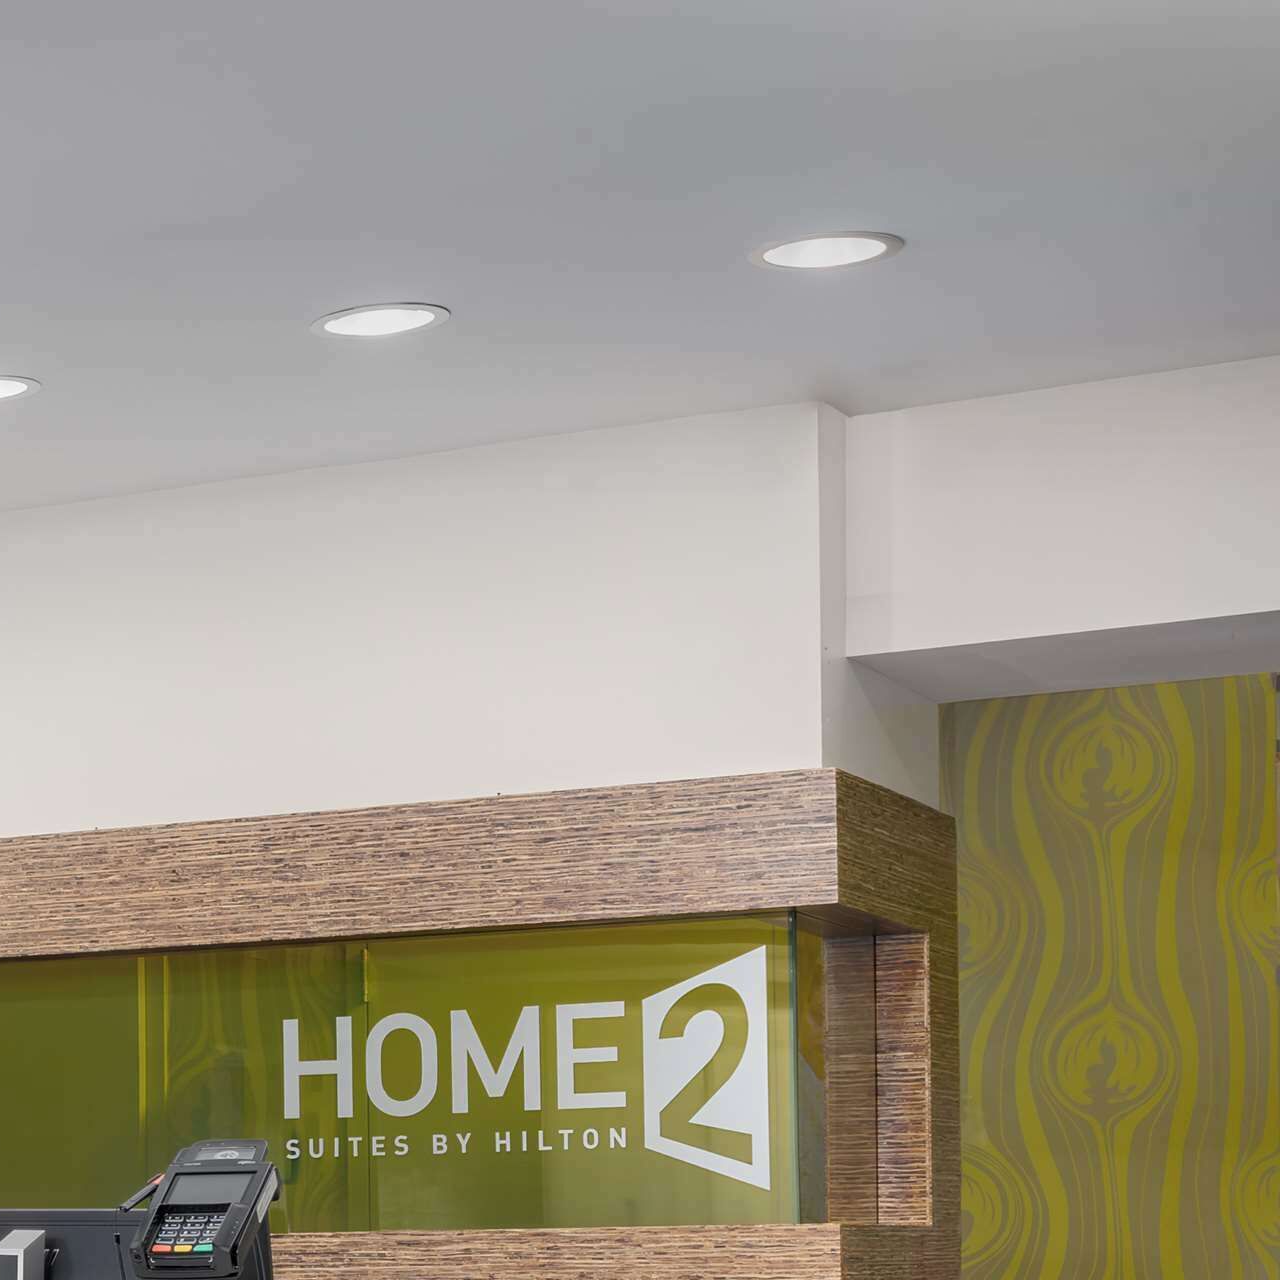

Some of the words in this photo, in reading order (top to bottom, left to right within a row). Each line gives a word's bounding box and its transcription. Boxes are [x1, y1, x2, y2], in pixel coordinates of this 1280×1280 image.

[282, 1000, 628, 1120] HOME
[653, 978, 758, 1170] 2
[285, 1134, 410, 1161] SUITES
[432, 1131, 472, 1156] BY
[494, 1126, 629, 1154] HILTON
